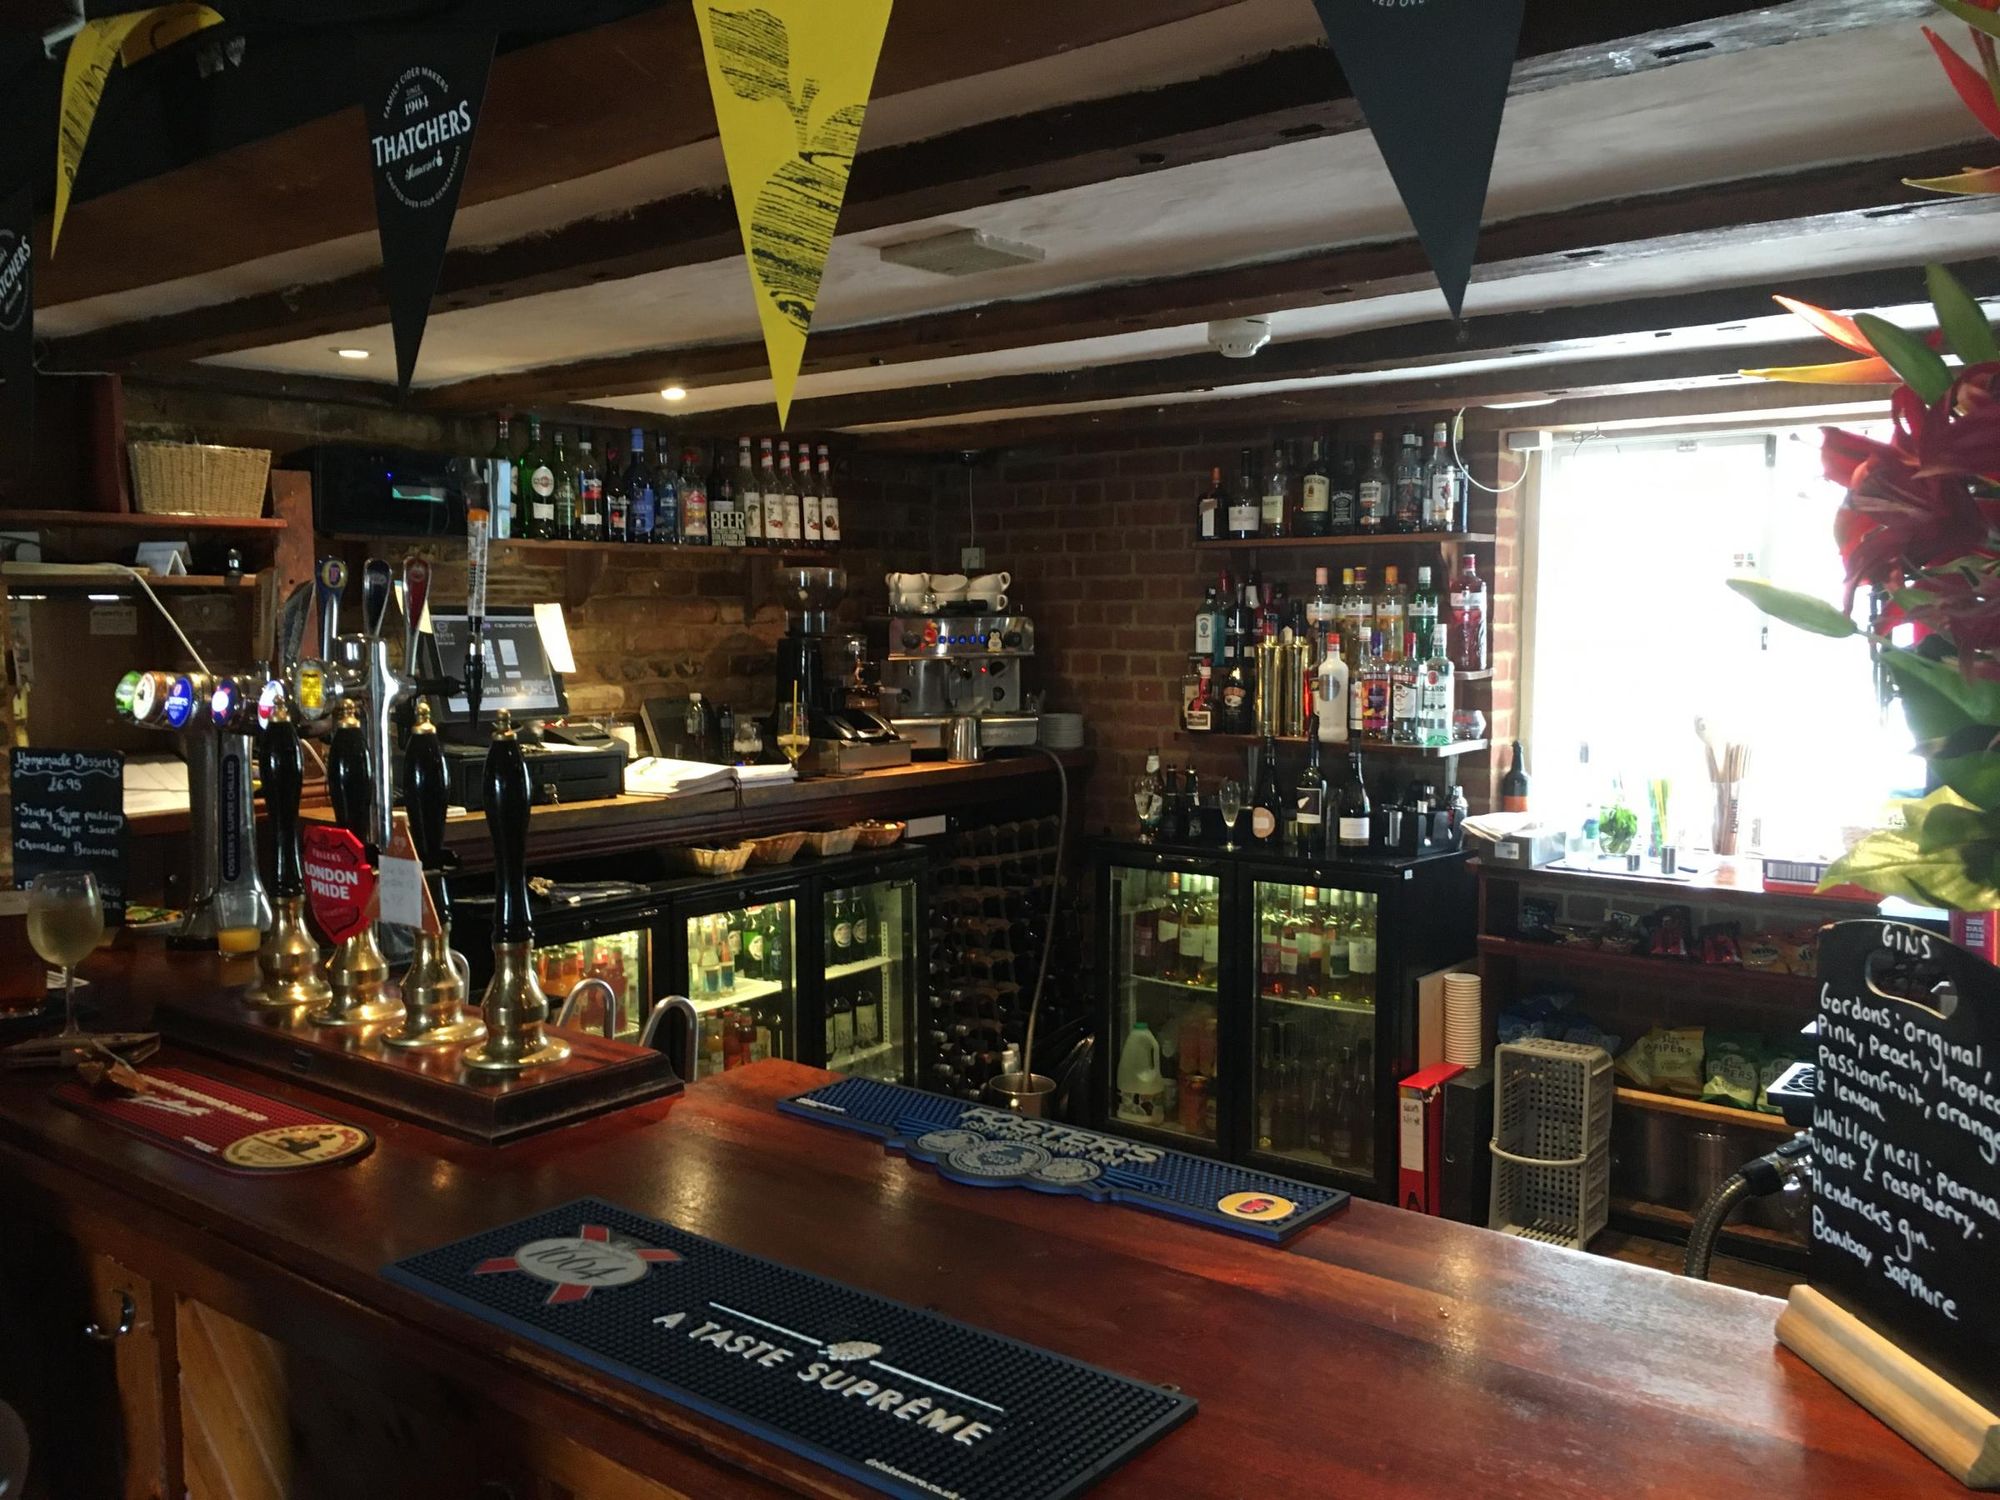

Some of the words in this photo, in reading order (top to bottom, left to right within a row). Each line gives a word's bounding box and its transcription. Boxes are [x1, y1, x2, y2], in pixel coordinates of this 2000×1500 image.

[400, 66, 420, 84] CIDER
[422, 67, 449, 93] MAKERS
[372, 100, 471, 168] THATCHERS
[711, 511, 745, 529] BEER
[15, 751, 71, 770] Homemade
[75, 754, 120, 770] Desserts
[48, 777, 82, 792] £6.95
[227, 760, 236, 800] CHILLED
[20, 803, 53, 824] Sticky
[227, 802, 236, 832] SUPER
[227, 833, 236, 877] FOSTER'S
[304, 861, 358, 886] LONDON
[311, 879, 350, 900] PRIDE
[1882, 924, 1931, 959] GINS
[1712, 1063, 1753, 1081] PIPERS
[1834, 1076, 1886, 1122] lemon
[1812, 1167, 1893, 1233] Hendricks
[1812, 1204, 1873, 1268] Bombay
[652, 1312, 686, 1329] A
[688, 1321, 794, 1367] TASTE
[797, 1362, 992, 1446] SUPRÊME
